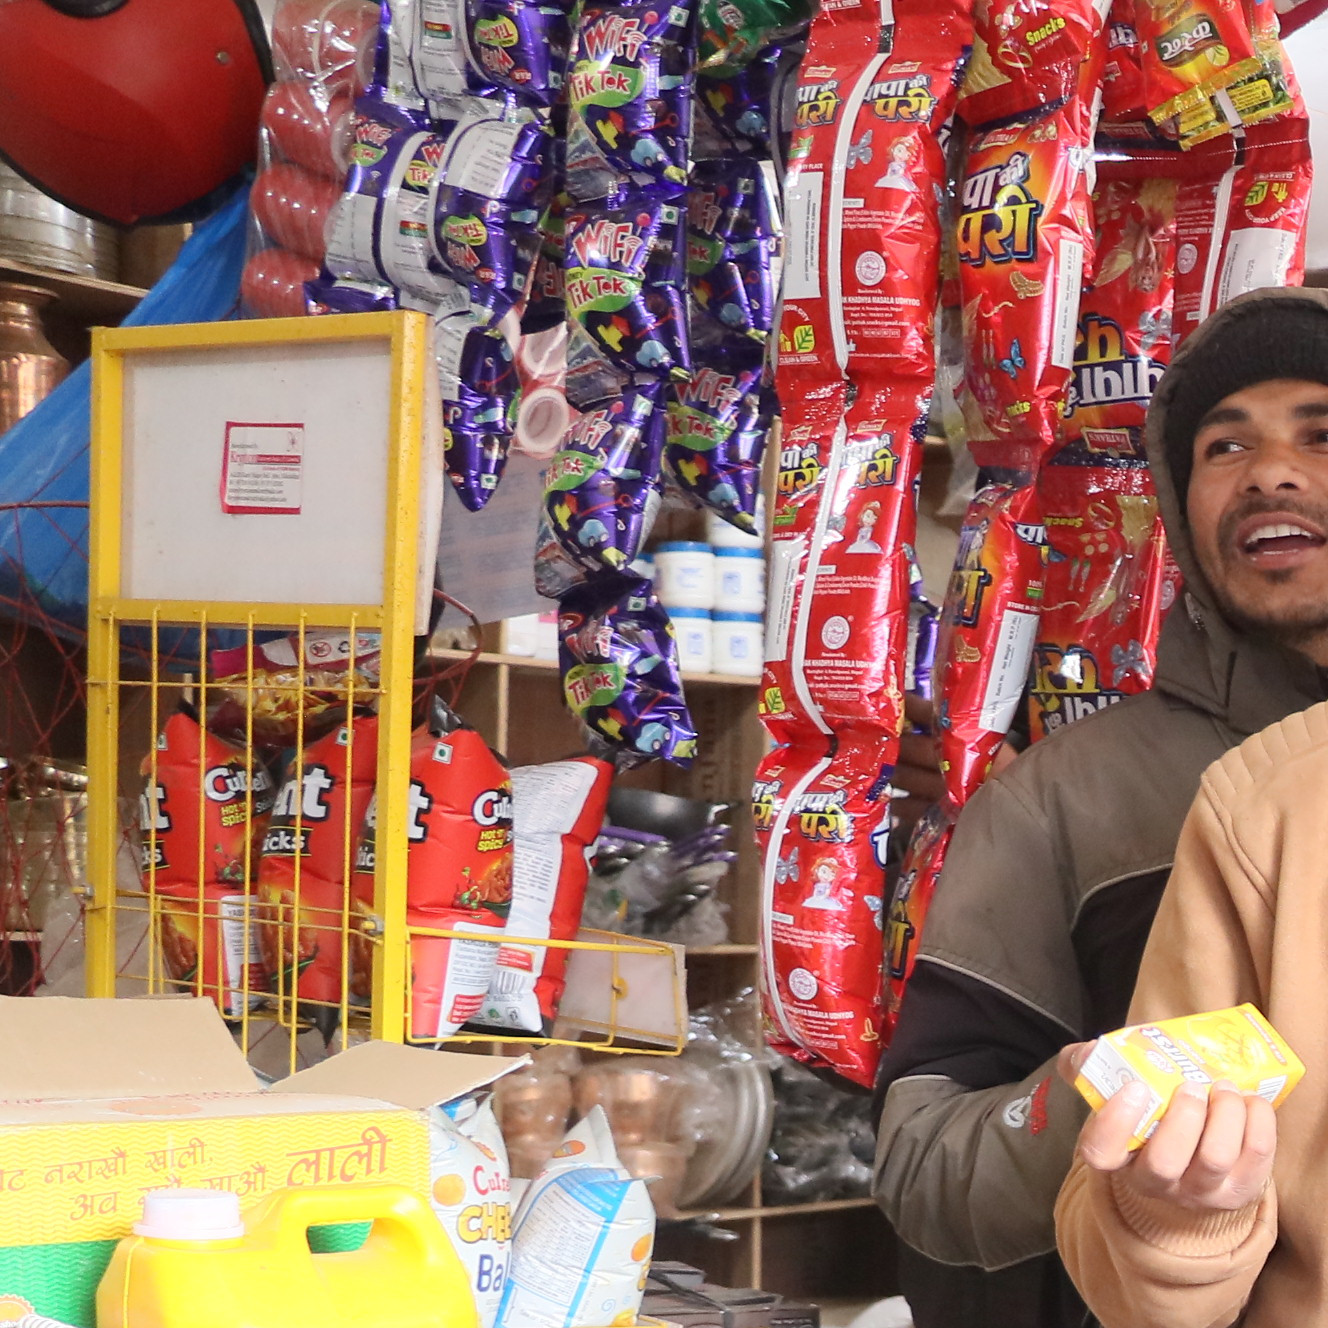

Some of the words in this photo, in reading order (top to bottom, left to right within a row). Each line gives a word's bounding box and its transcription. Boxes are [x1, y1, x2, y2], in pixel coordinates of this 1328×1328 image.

[585, 15, 647, 61] WiFi
[1025, 17, 1065, 44] Snacks
[599, 67, 632, 93] Tok
[874, 88, 937, 122] परी
[996, 153, 1029, 188] की
[957, 184, 1042, 264] परी
[573, 219, 643, 269] WiFi
[567, 279, 595, 312] Tik
[592, 275, 627, 299] Tok
[799, 804, 853, 842] परी
[1140, 1026, 1213, 1086] Burrst
[286, 1126, 394, 1188] लाली
